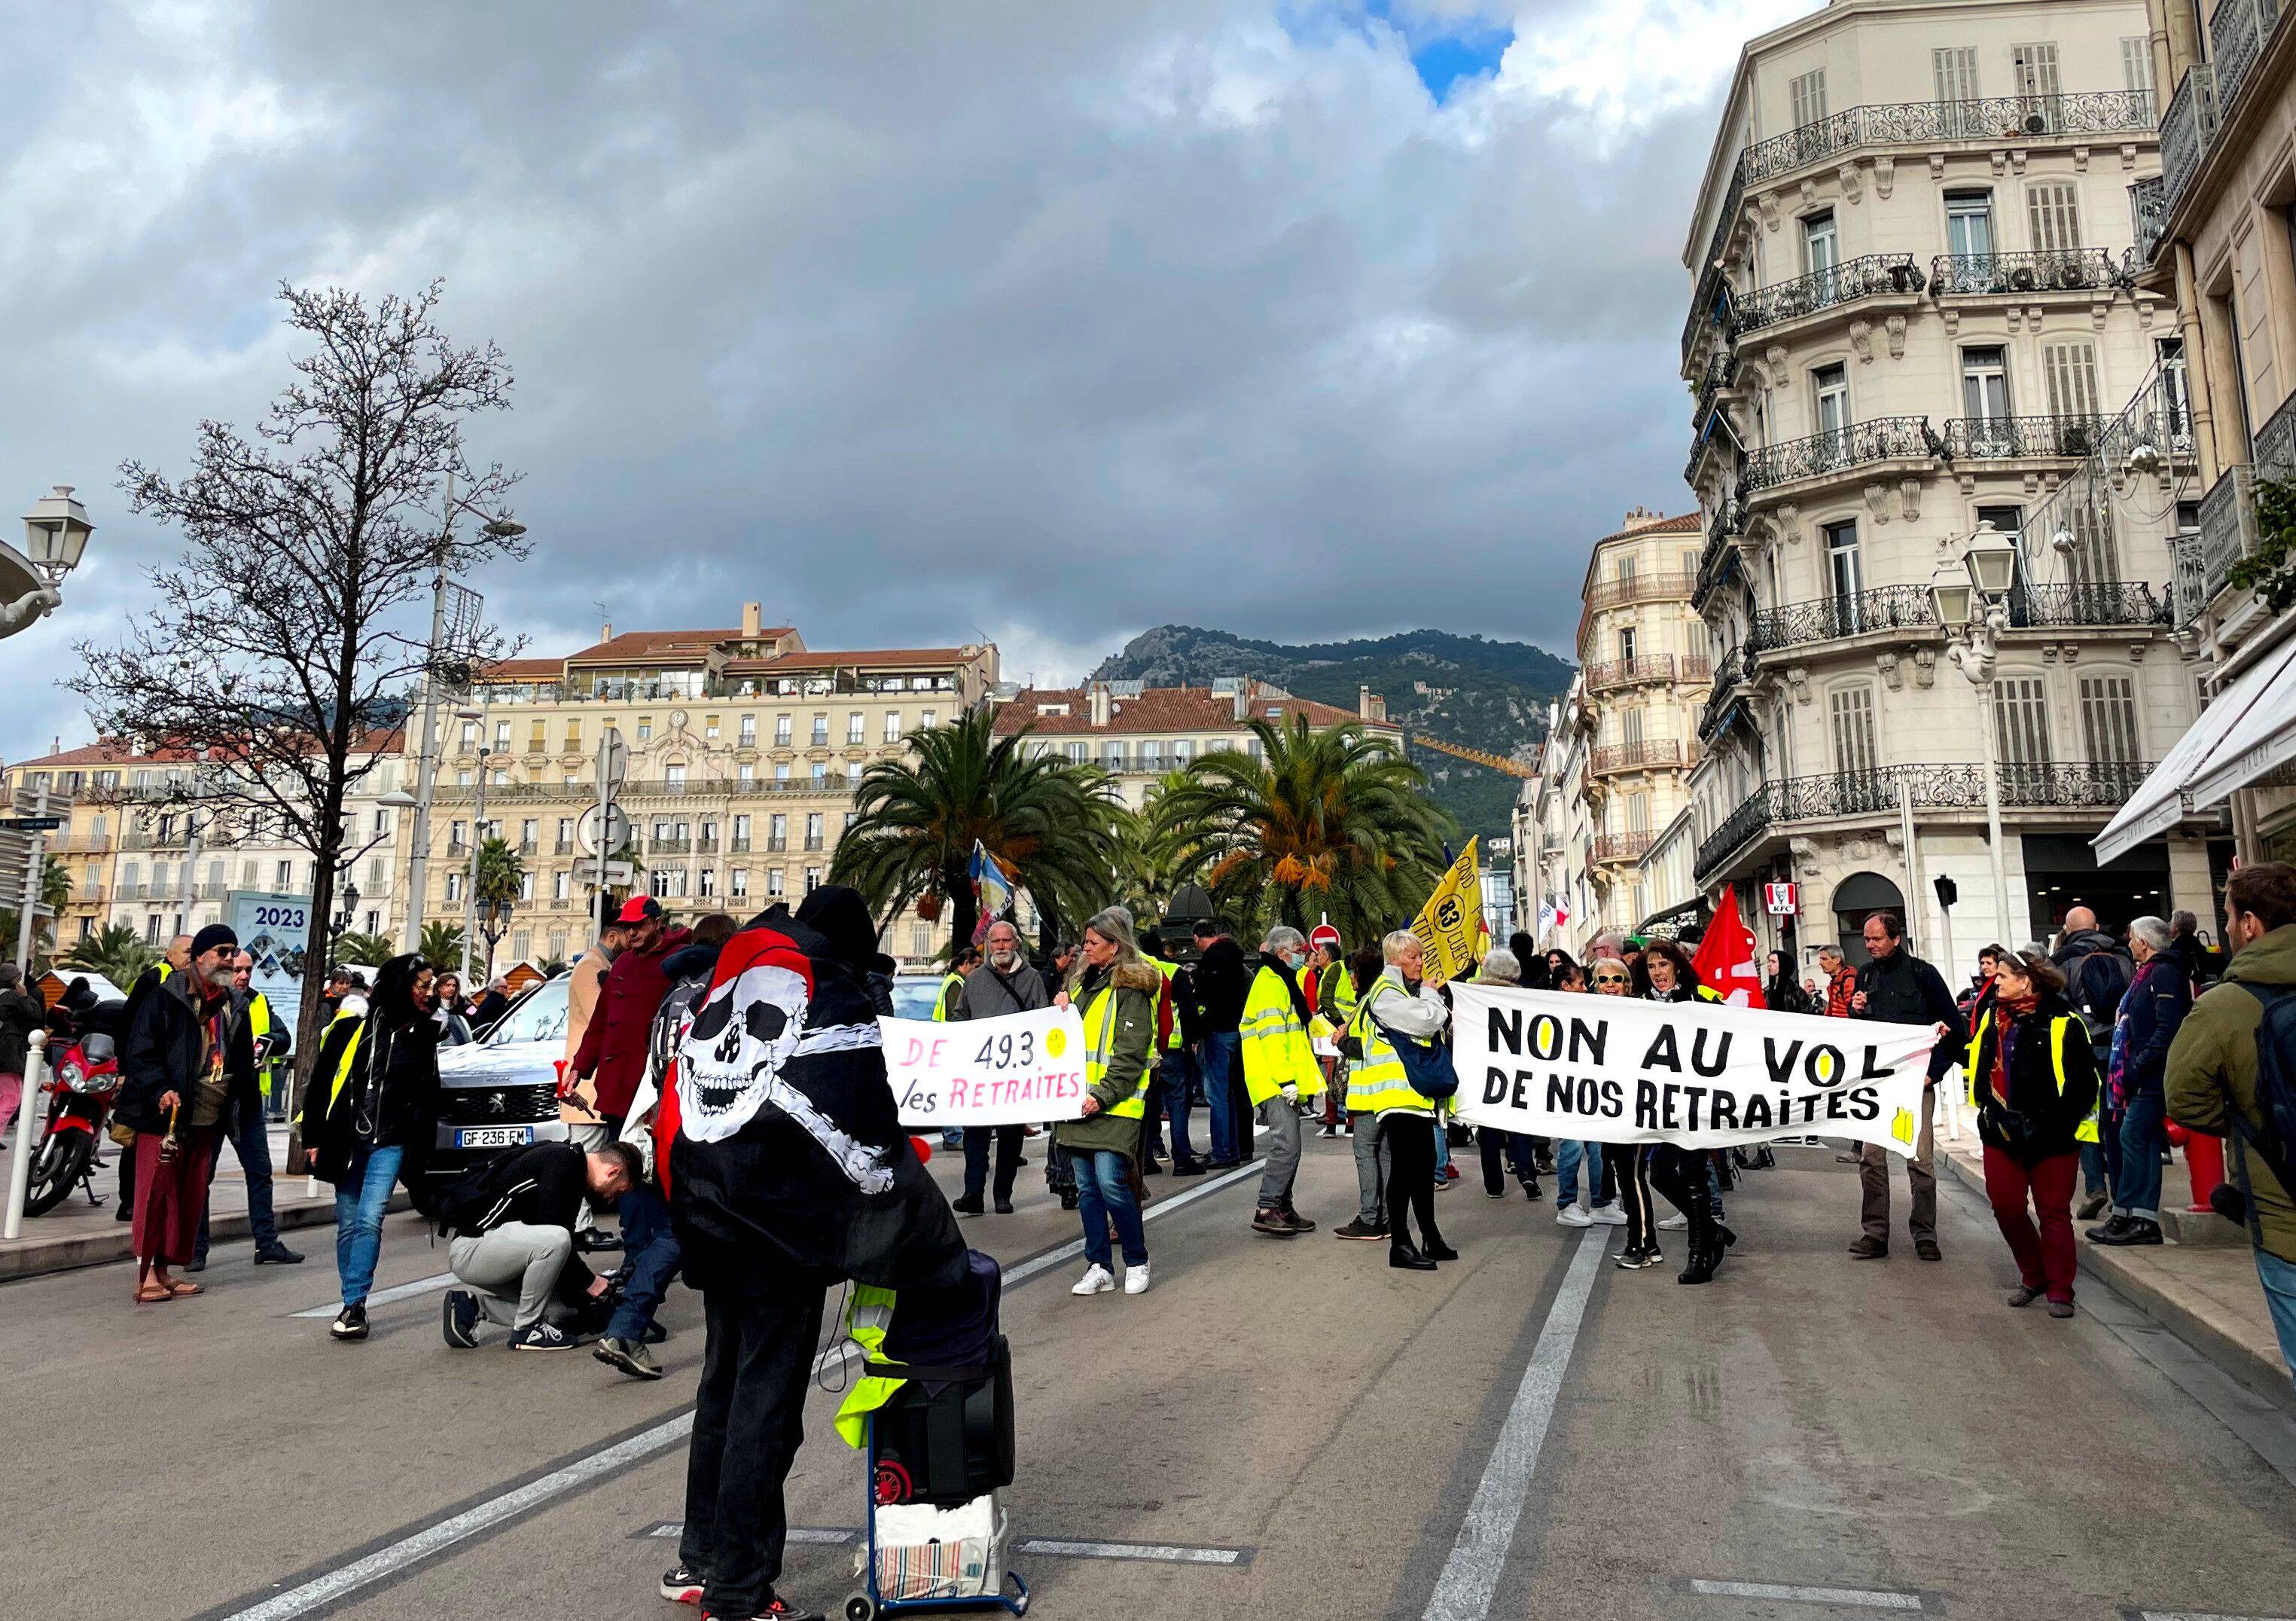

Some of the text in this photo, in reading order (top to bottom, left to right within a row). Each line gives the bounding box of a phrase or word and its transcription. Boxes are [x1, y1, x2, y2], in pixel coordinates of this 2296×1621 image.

[255, 906, 304, 927] 2023
[1438, 899, 1470, 972] 83 CUERS
[899, 1030, 1034, 1070] DE 49.3
[1488, 1006, 1895, 1088] NON AU VOL
[899, 1079, 938, 1113] les
[1482, 1066, 1532, 1110] DE
[1546, 1073, 1624, 1118] NOS
